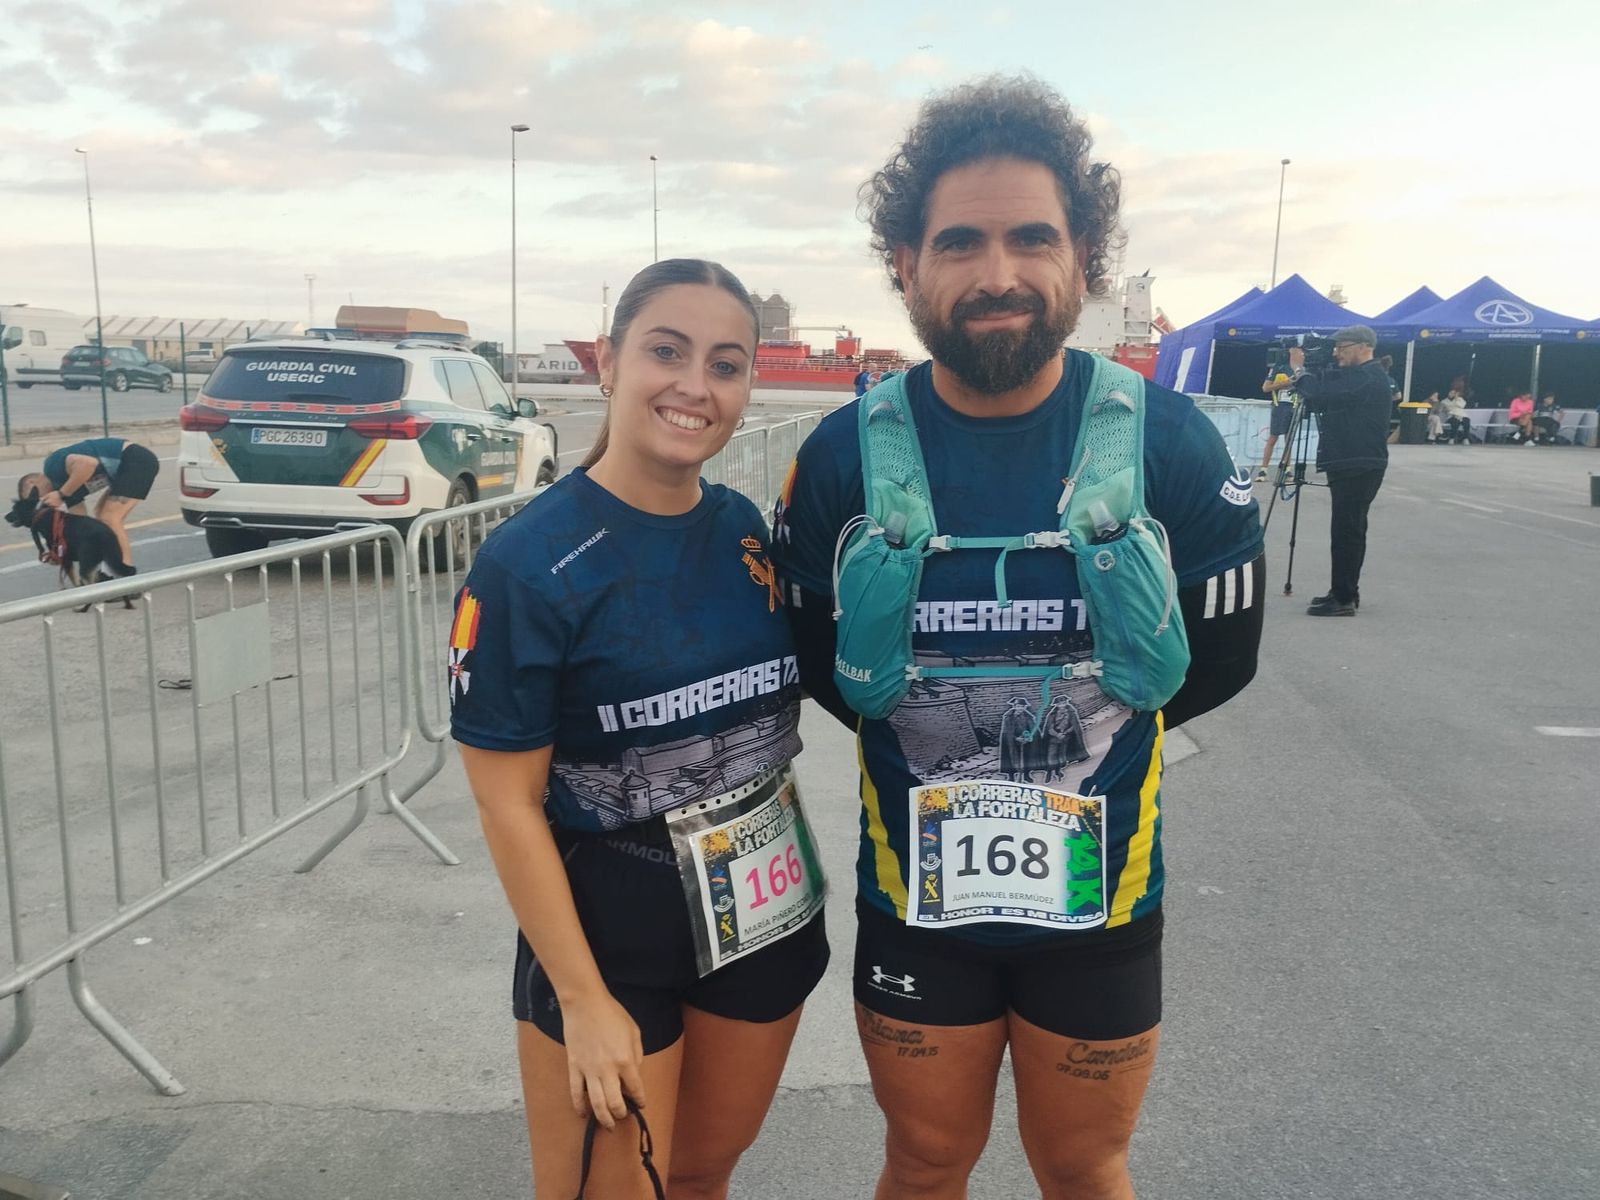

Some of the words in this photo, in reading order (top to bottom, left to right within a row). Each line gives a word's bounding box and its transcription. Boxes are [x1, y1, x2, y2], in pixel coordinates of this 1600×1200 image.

[245, 361, 314, 372] GUARDIA
[319, 363, 357, 376] CIVIL
[267, 372, 326, 384] USECIC
[550, 527, 611, 575] FIREHAWK
[958, 784, 1043, 807] CORRERAS
[952, 801, 976, 819] LA
[978, 801, 1081, 832] FORTALEZA
[956, 834, 1050, 880] 168
[745, 843, 803, 911] 166
[952, 892, 970, 902] JUAN
[972, 891, 1007, 900] MANUEL
[1009, 892, 1055, 905] BERMÚDEZ
[941, 907, 994, 921] HONOR
[1001, 908, 1025, 916] ES
[1050, 911, 1104, 923] DIVISA
